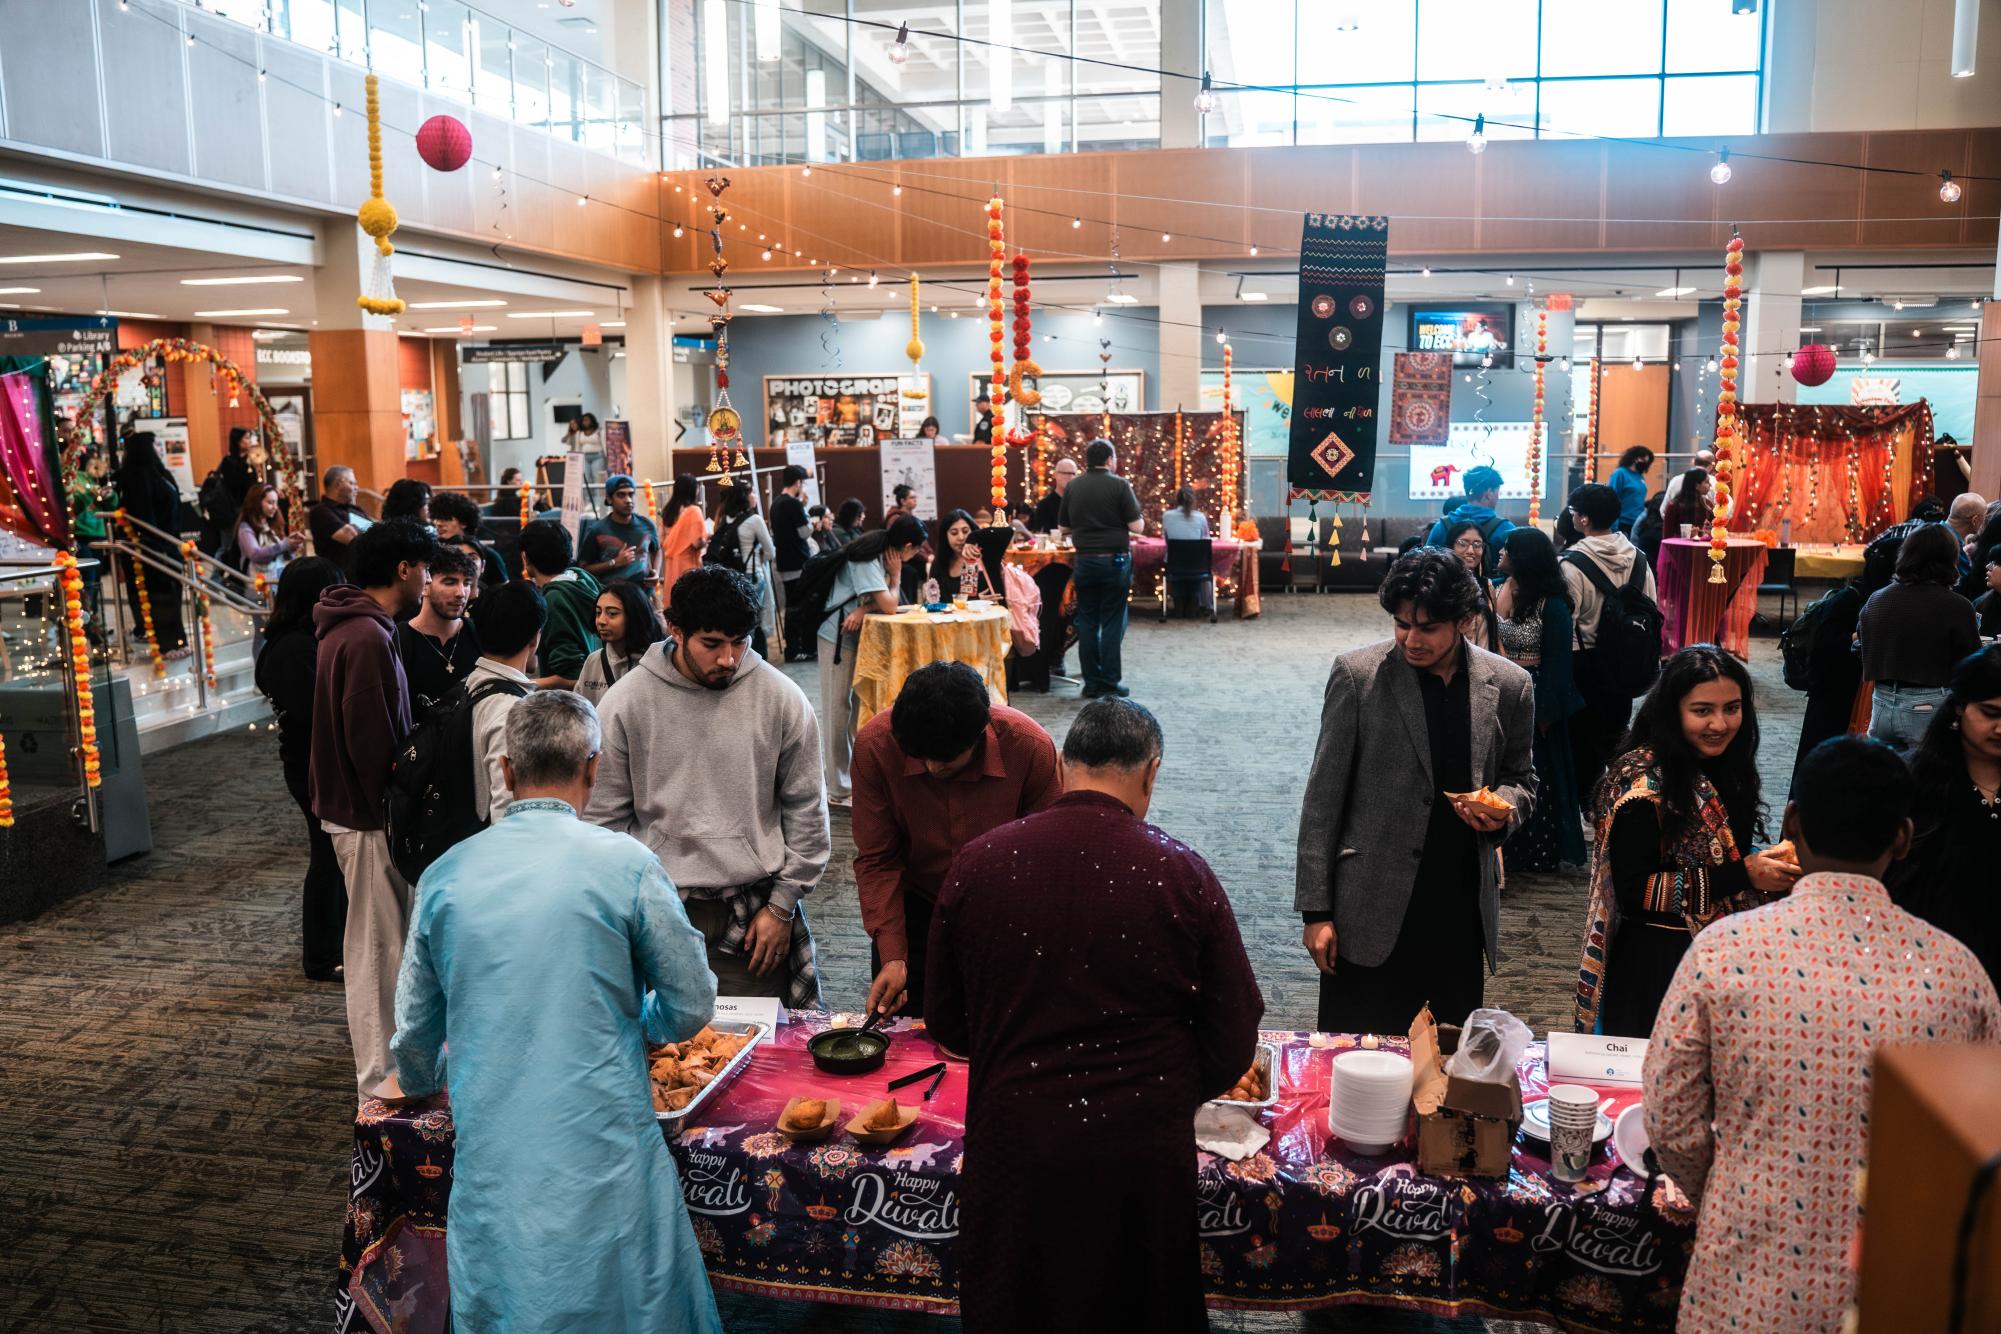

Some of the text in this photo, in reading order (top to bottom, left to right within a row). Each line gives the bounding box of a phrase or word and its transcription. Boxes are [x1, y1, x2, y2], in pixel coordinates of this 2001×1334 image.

[8, 319, 18, 333] B
[82, 331, 110, 341] Library
[1420, 335, 1433, 350] TO
[66, 342, 95, 353] Parking
[1606, 1043, 1628, 1053] Chai
[894, 1171, 940, 1195] Happy
[1395, 1178, 1437, 1200] Happy
[844, 1172, 960, 1236] Diwali
[1590, 1204, 1639, 1230] Happy
[1532, 1201, 1660, 1272] Diwali
